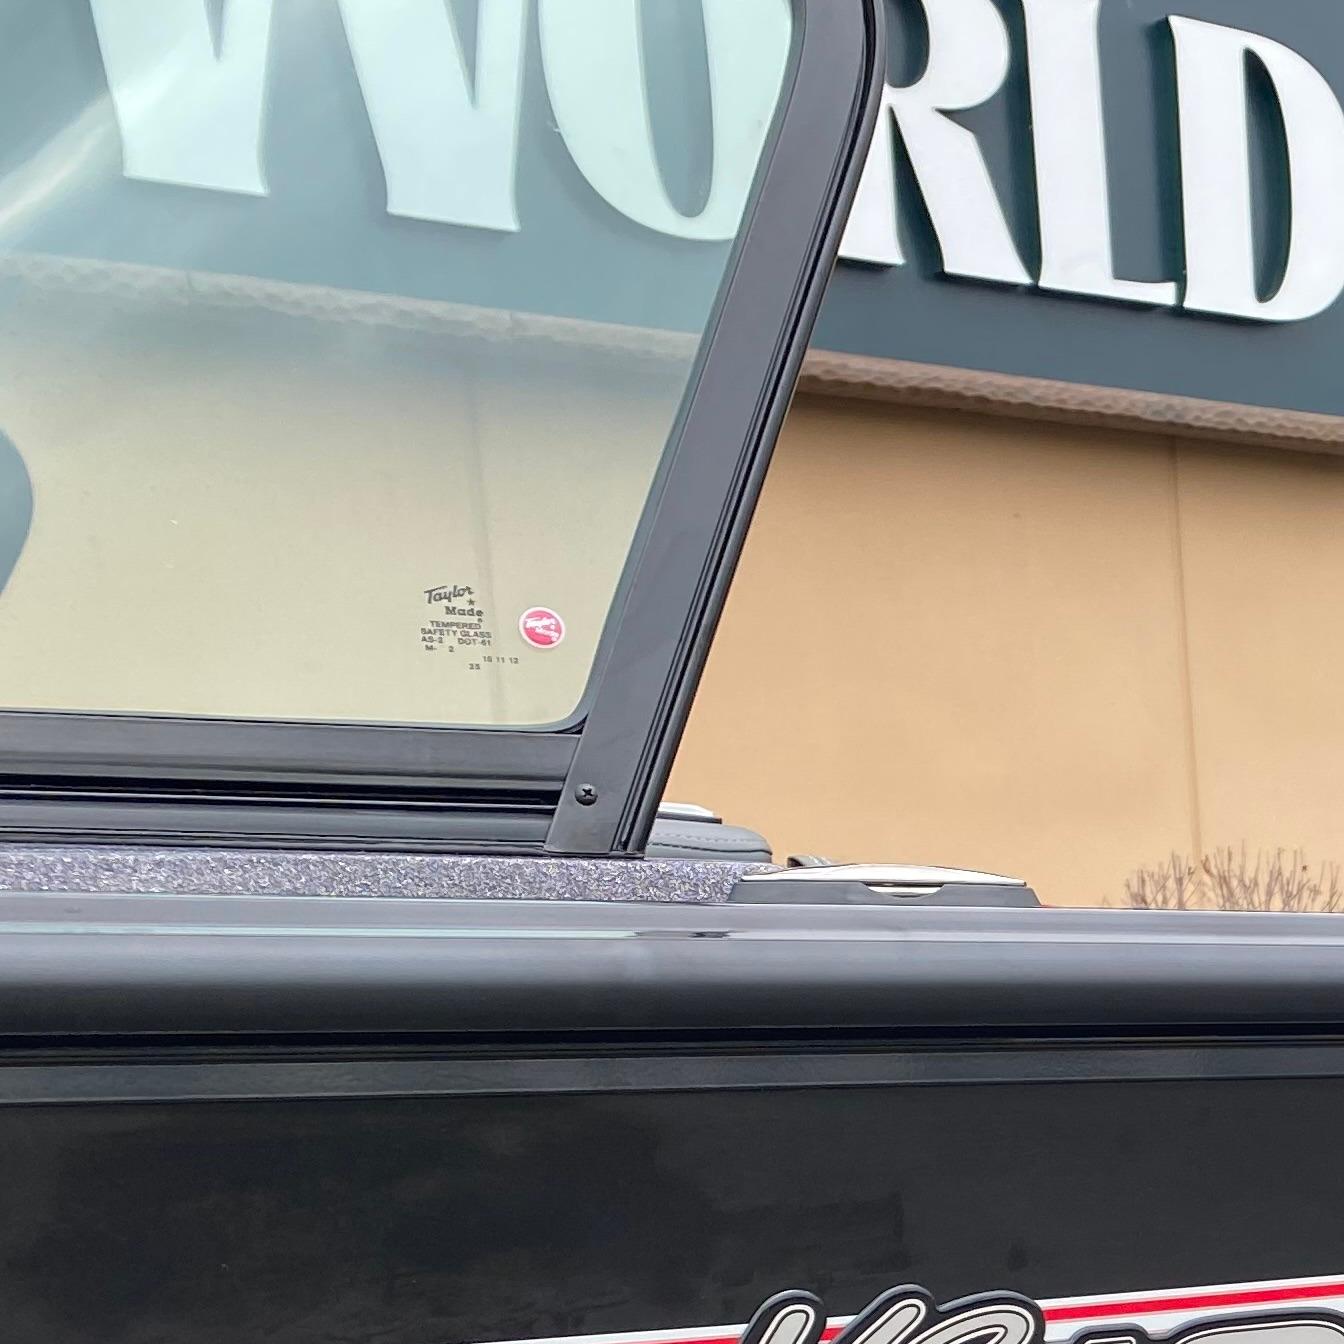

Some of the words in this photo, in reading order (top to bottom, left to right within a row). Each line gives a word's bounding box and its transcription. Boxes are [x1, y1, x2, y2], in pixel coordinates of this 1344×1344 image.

[424, 585, 474, 604] Taylor
[444, 606, 484, 617] Made
[430, 620, 482, 630] TEMPERED
[420, 628, 458, 637] SAFETY
[460, 631, 492, 639] GLASS
